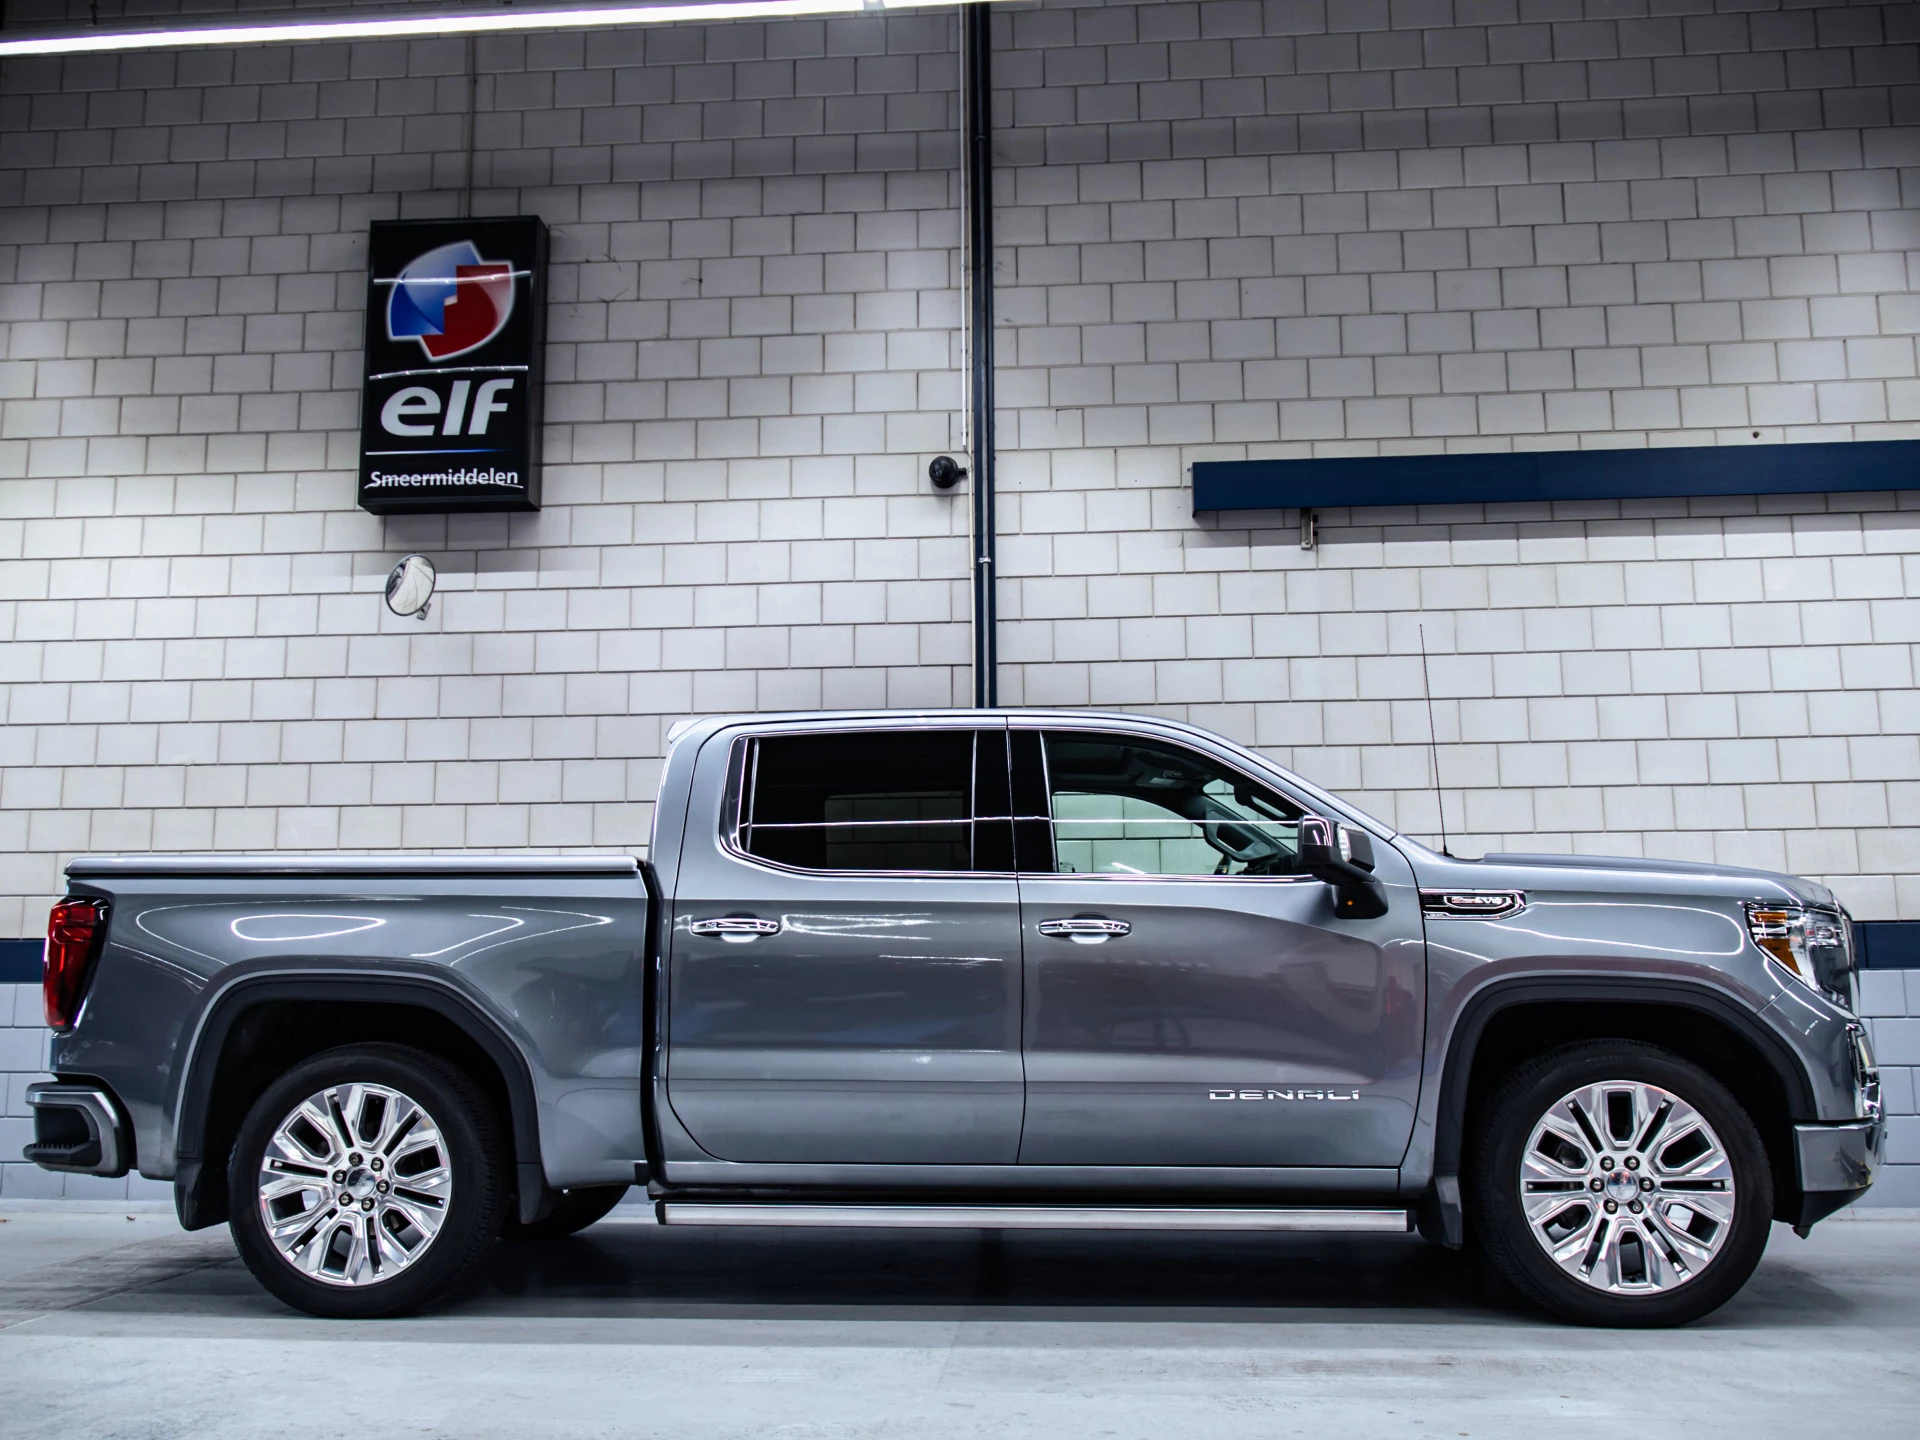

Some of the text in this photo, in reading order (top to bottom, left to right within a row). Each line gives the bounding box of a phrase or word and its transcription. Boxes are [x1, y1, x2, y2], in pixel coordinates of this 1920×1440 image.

[380, 378, 514, 437] elf
[370, 468, 519, 488] Smeermiddelen
[1208, 1089, 1360, 1101] DENALI
